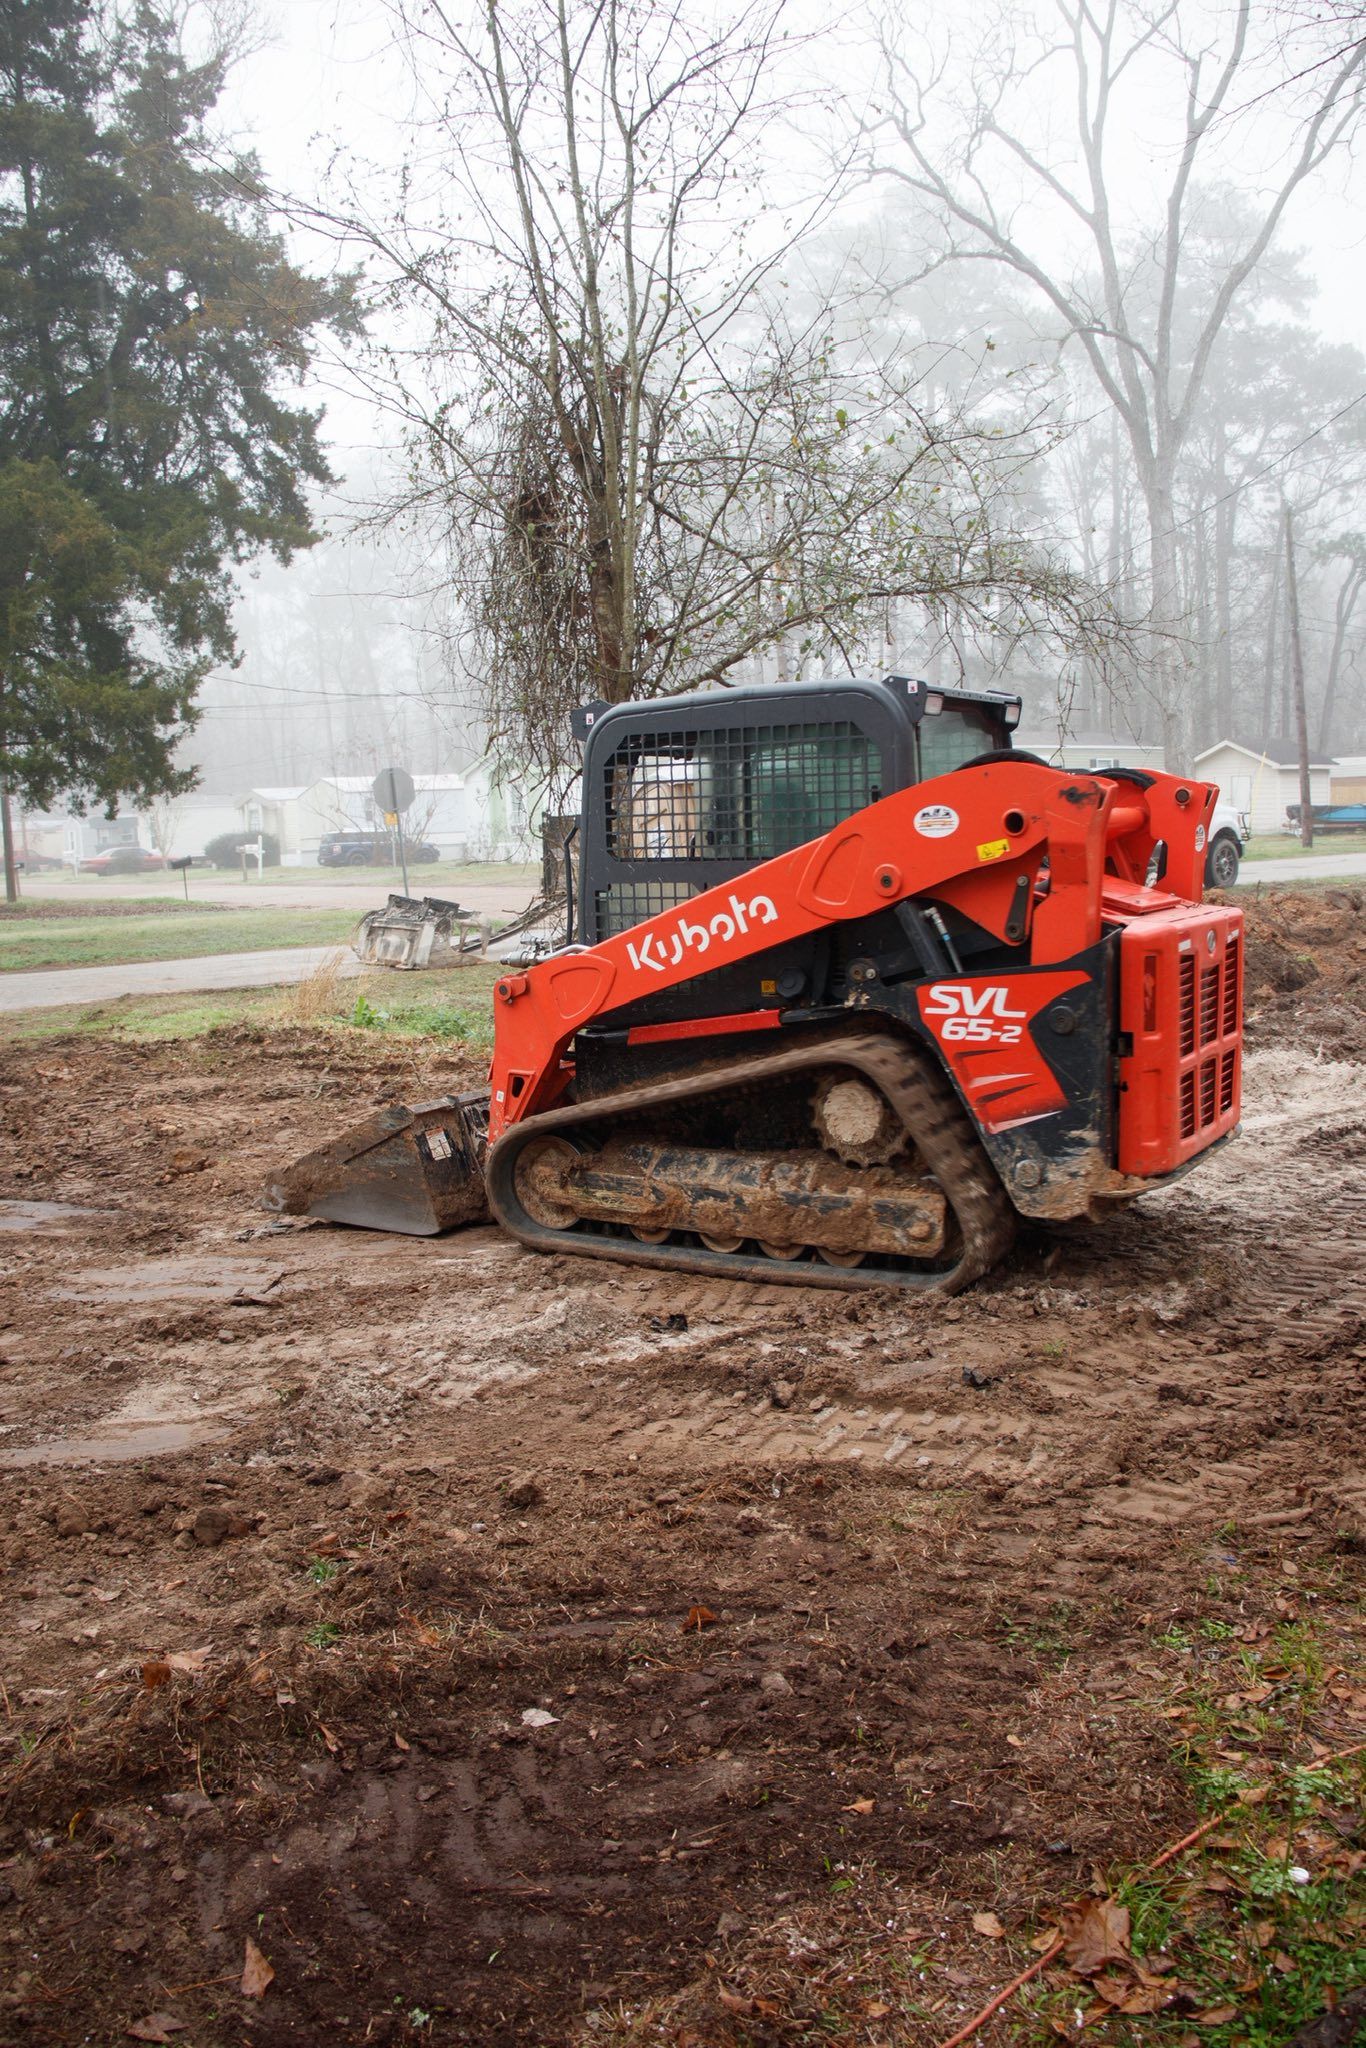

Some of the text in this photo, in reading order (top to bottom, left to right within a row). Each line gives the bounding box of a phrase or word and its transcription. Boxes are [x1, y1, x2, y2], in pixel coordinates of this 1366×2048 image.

[626, 895, 778, 971] Kubota
[924, 985, 1027, 1018] SVL
[941, 1018, 1023, 1043] 65-2
